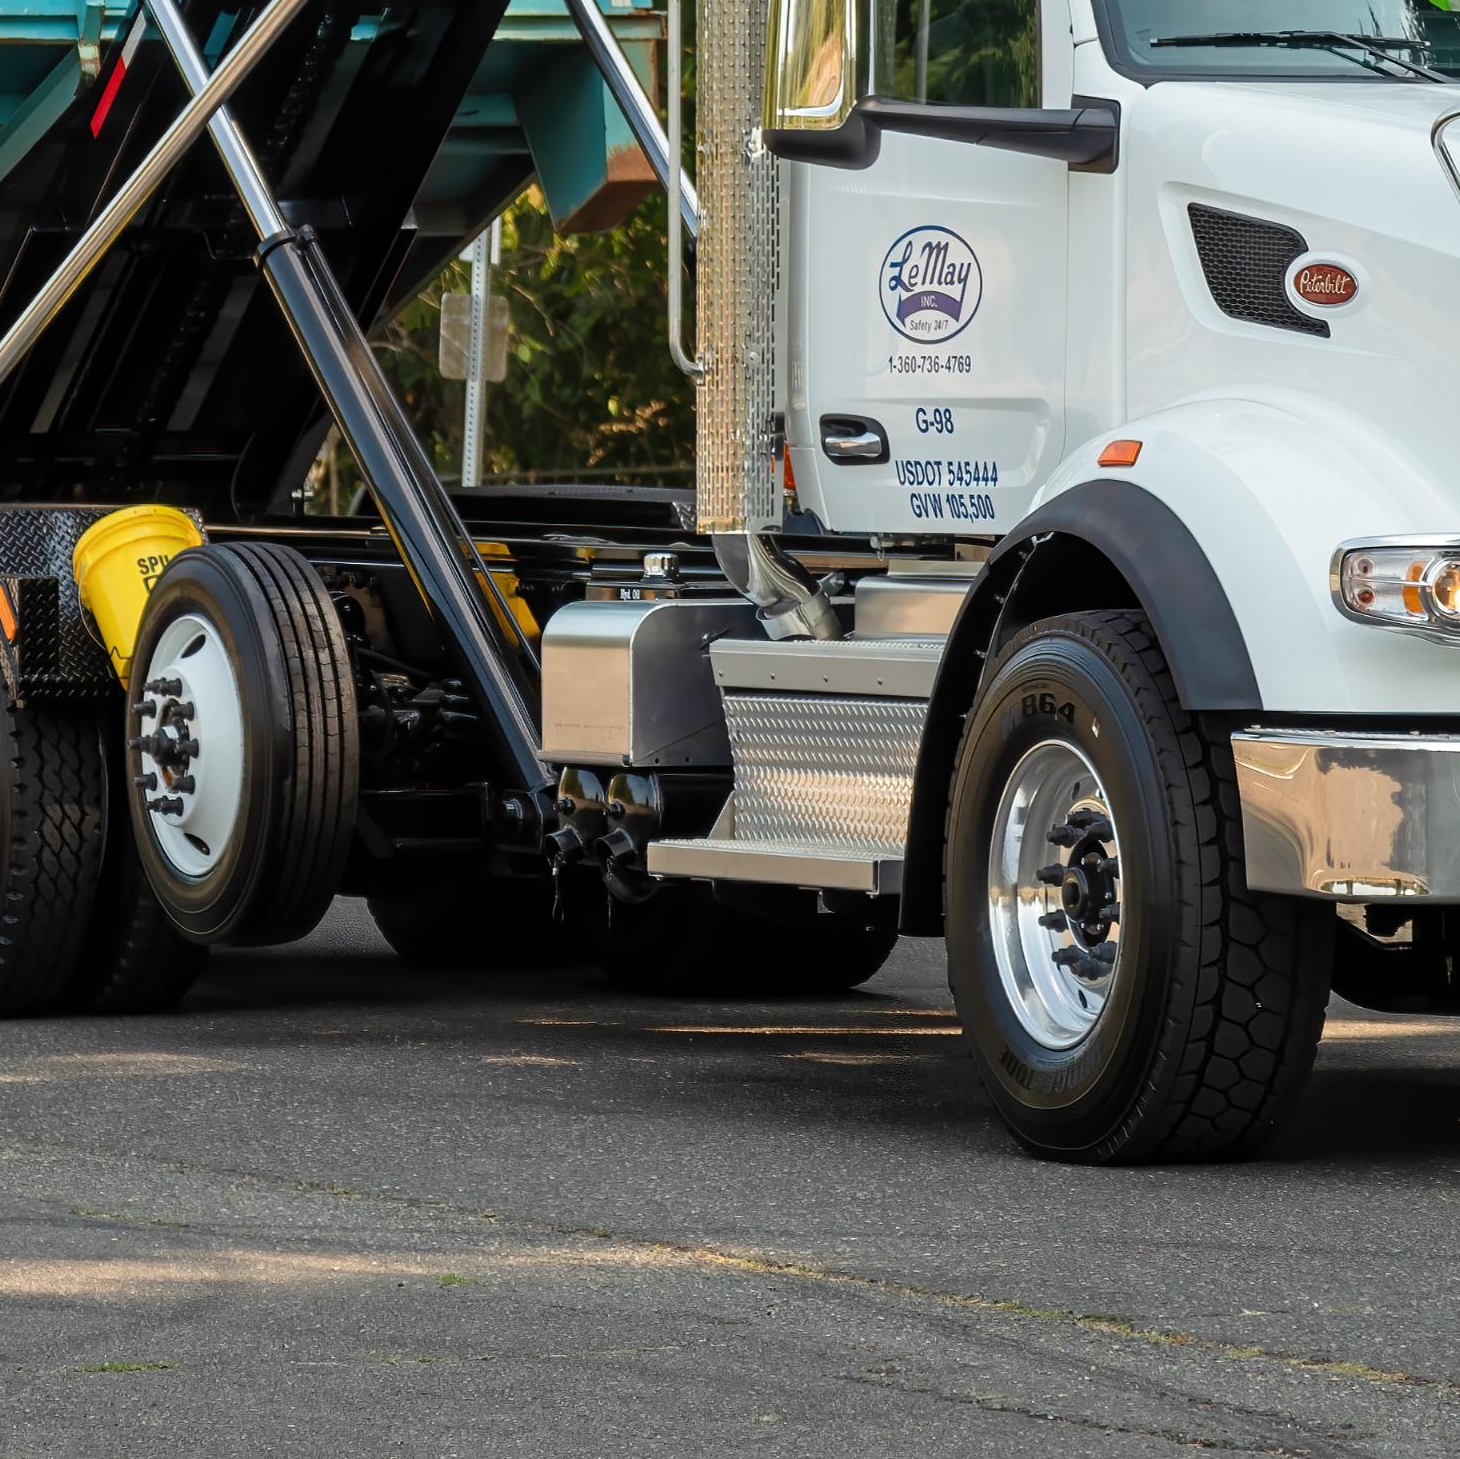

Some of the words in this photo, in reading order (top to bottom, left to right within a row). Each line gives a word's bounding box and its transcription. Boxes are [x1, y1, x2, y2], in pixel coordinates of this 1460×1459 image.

[1300, 269, 1351, 295] Peterbilt
[921, 295, 938, 308] INC.
[910, 320, 932, 333] Safety
[934, 319, 949, 331] 24/7
[888, 355, 972, 374] 1-360-736-4769
[915, 407, 954, 434] G-98
[895, 460, 942, 486] USDOT
[947, 461, 998, 487] 545444
[910, 493, 944, 519] GVW
[946, 493, 995, 523] 105,500
